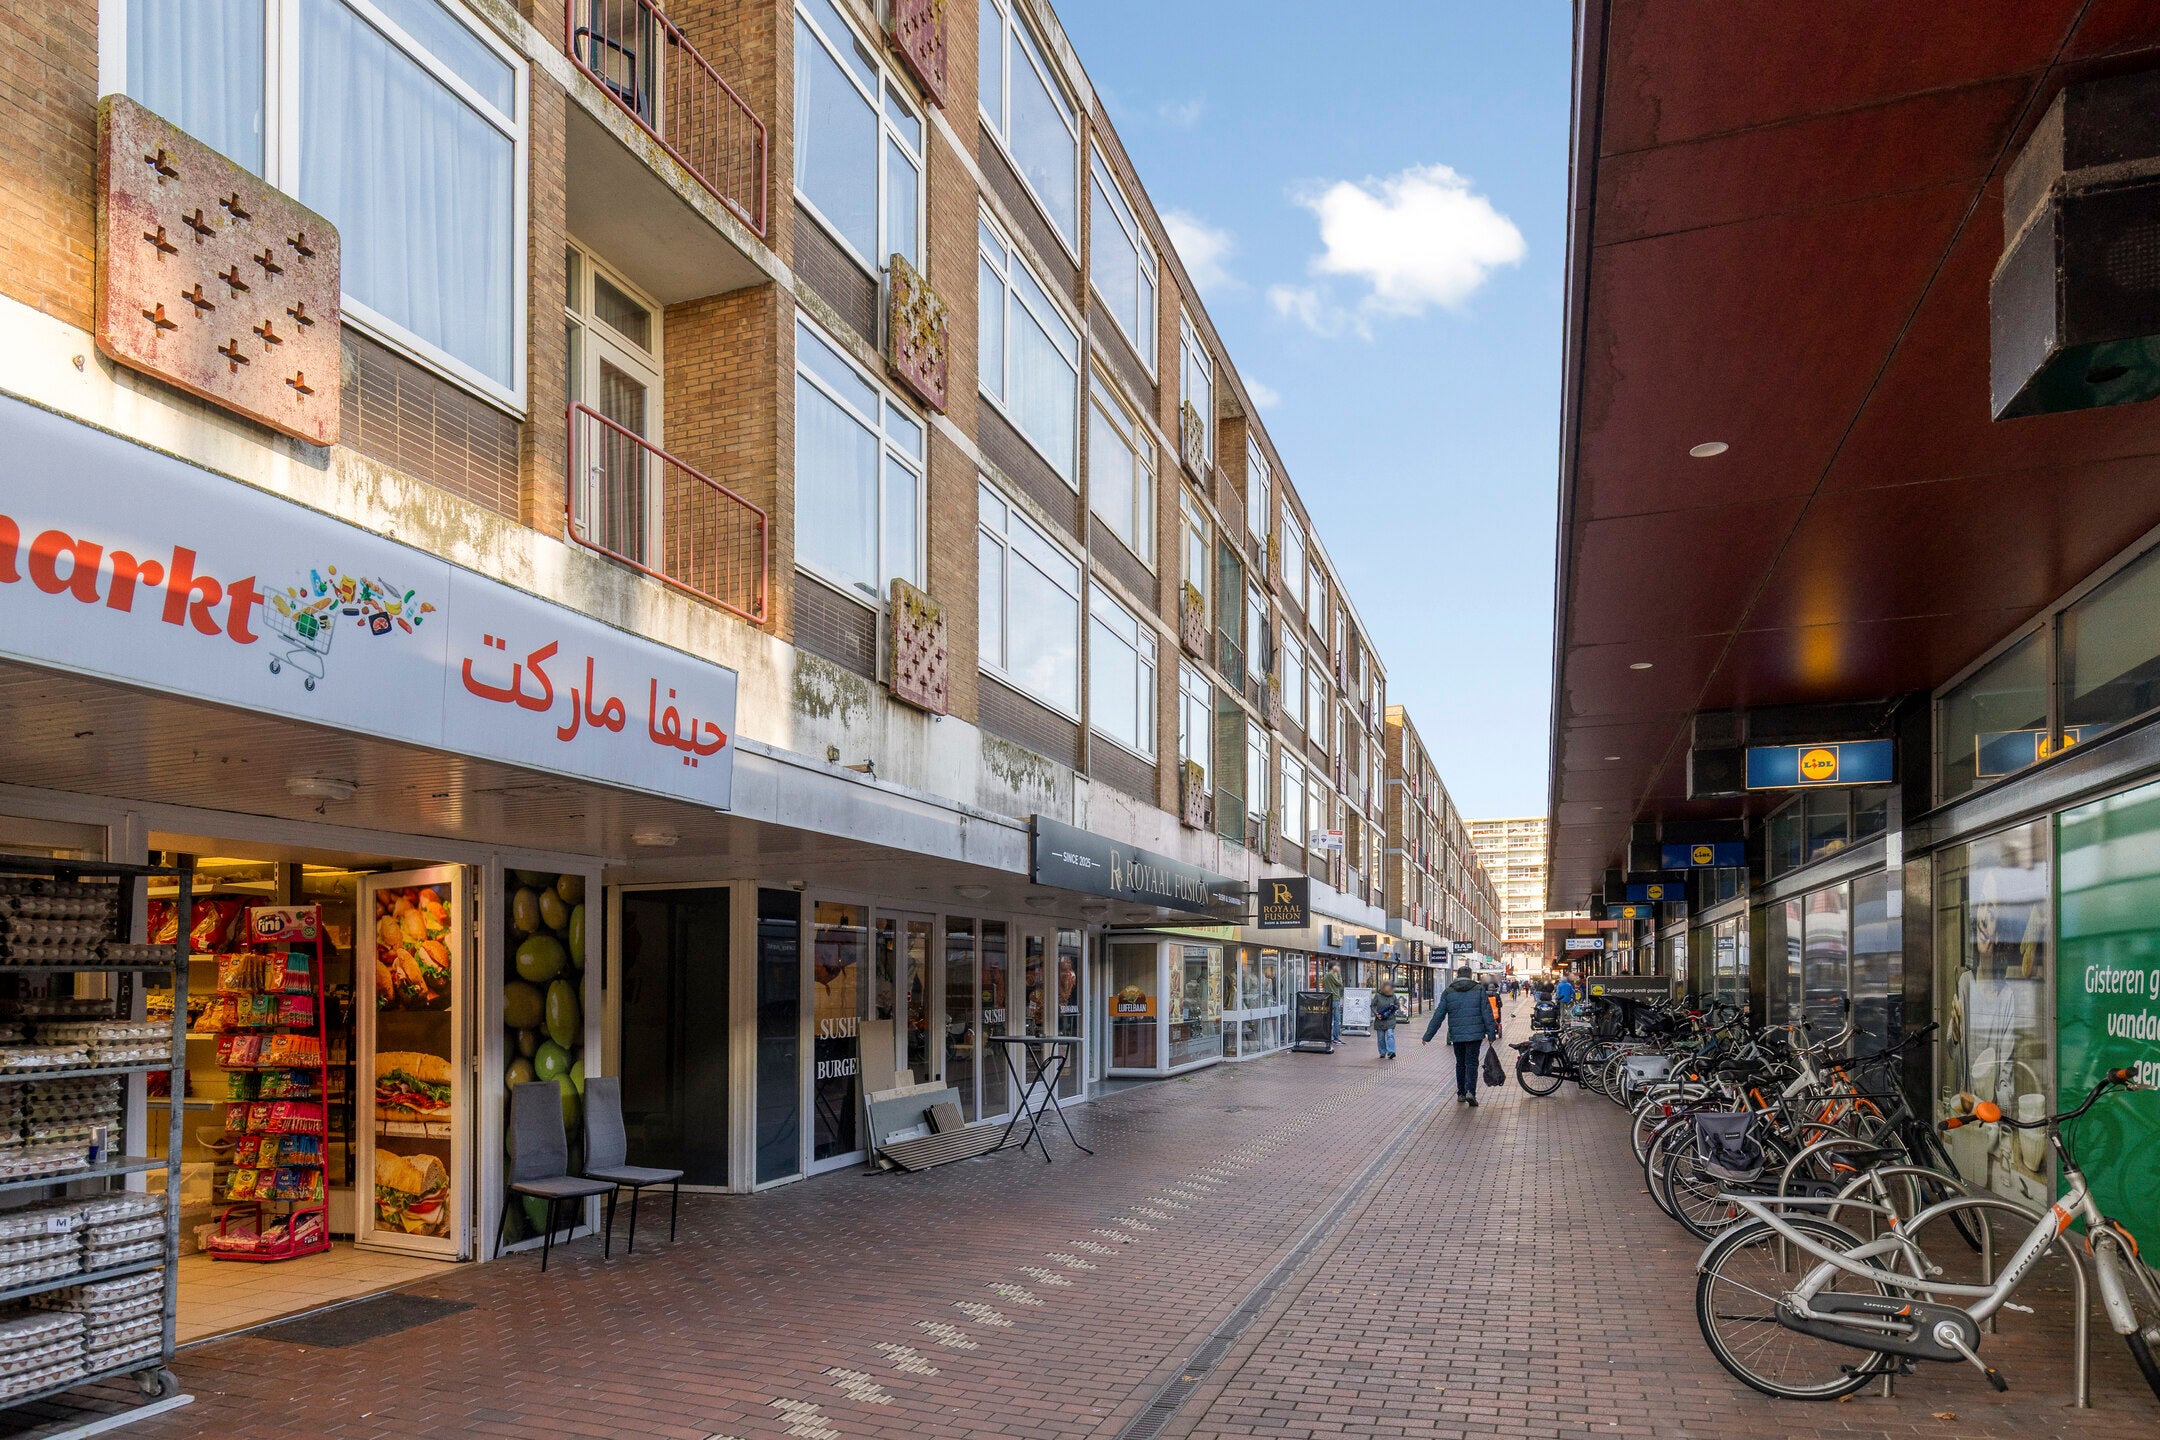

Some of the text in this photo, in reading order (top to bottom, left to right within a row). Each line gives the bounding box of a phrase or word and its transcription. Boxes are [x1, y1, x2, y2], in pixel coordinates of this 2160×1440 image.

[462, 634, 728, 768] حيفا ماركت
[1062, 851, 1091, 868] SINCE 2025
[1126, 860, 1171, 897] ROYAAL
[1174, 874, 1209, 905] FUSION
[1263, 904, 1302, 913] ROYAAL
[1264, 912, 1301, 921] FUSION
[2085, 964, 2144, 994] Gisteren
[1118, 1003, 1147, 1012] LUIFELBAAN
[984, 1008, 1006, 1024] SUSHI
[2009, 1233, 2049, 1283] UNION
[1863, 1302, 1900, 1310] UNION
